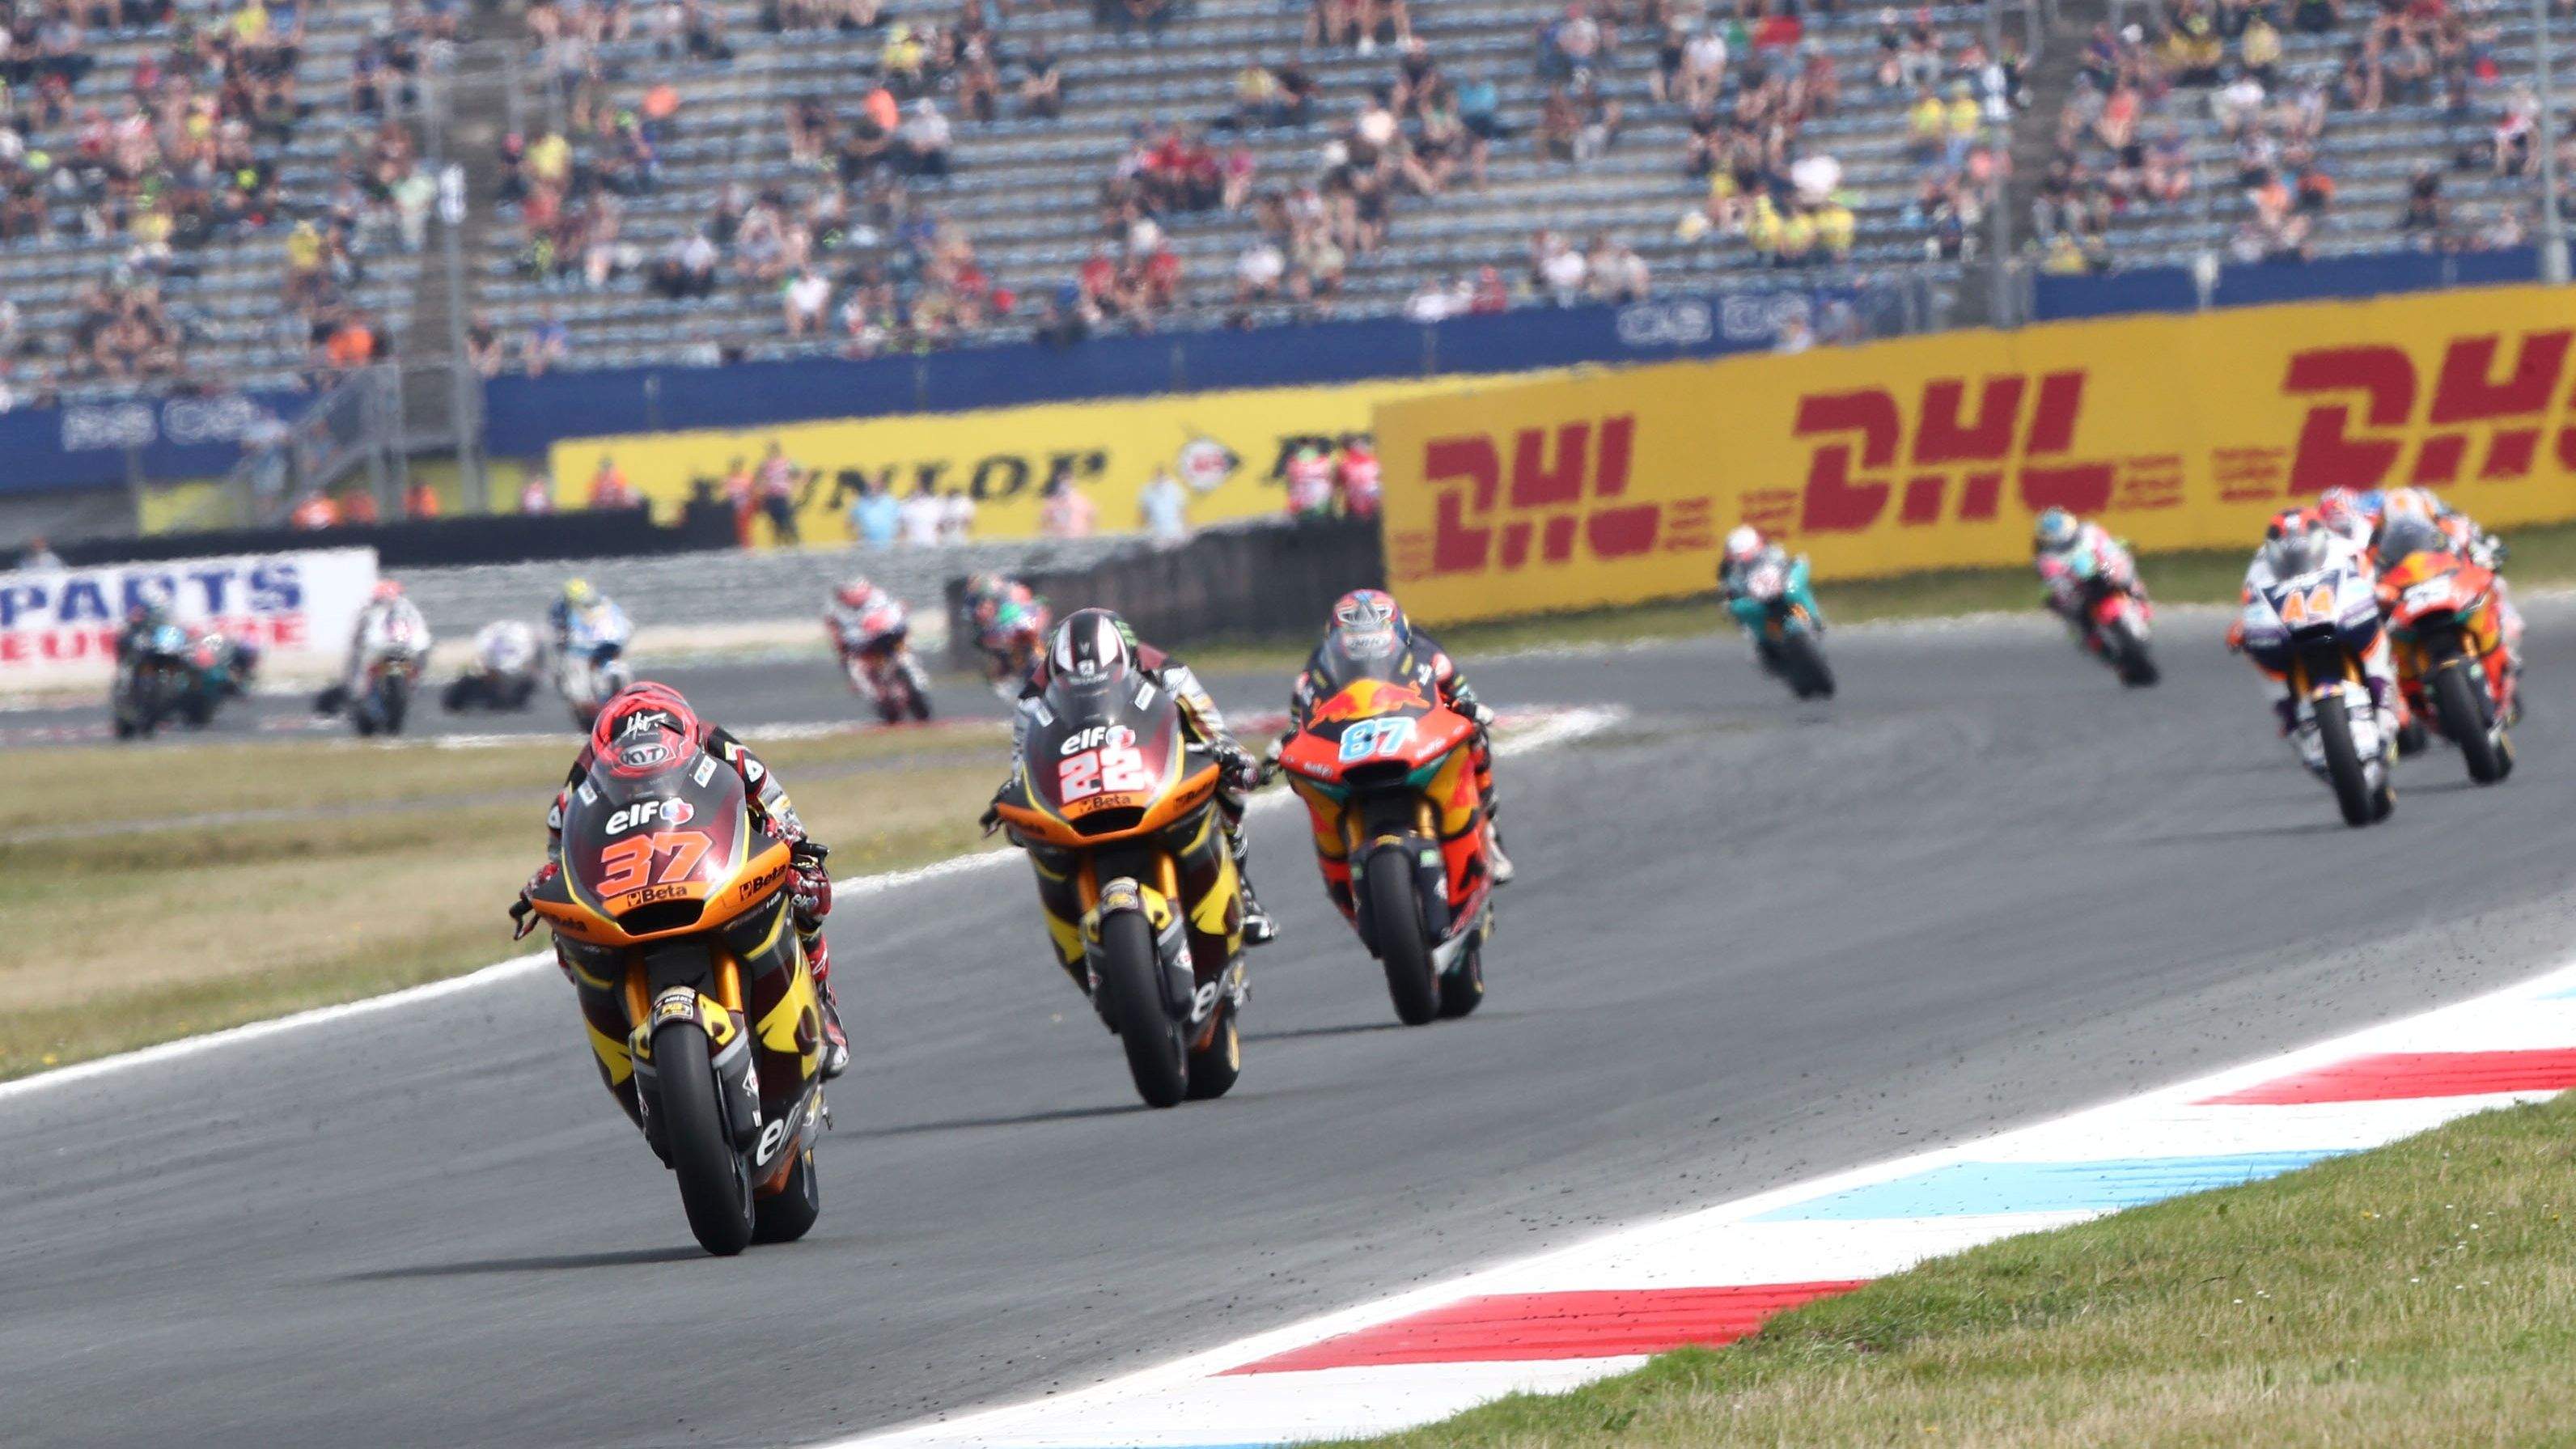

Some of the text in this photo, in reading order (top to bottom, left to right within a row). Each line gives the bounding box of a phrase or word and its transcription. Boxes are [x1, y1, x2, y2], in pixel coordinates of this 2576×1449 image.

[2282, 329, 2576, 496] DH
[1794, 370, 2116, 532] DHL
[1426, 413, 1661, 574] DHL
[2281, 584, 2335, 625] 44
[1061, 726, 1105, 755] elf
[1339, 718, 1417, 763] 87
[1058, 747, 1145, 804] 22
[605, 801, 661, 835] elf
[1093, 794, 1132, 807] Beta
[596, 832, 713, 897] 37
[752, 864, 786, 893] Beta
[642, 884, 688, 903] Beta
